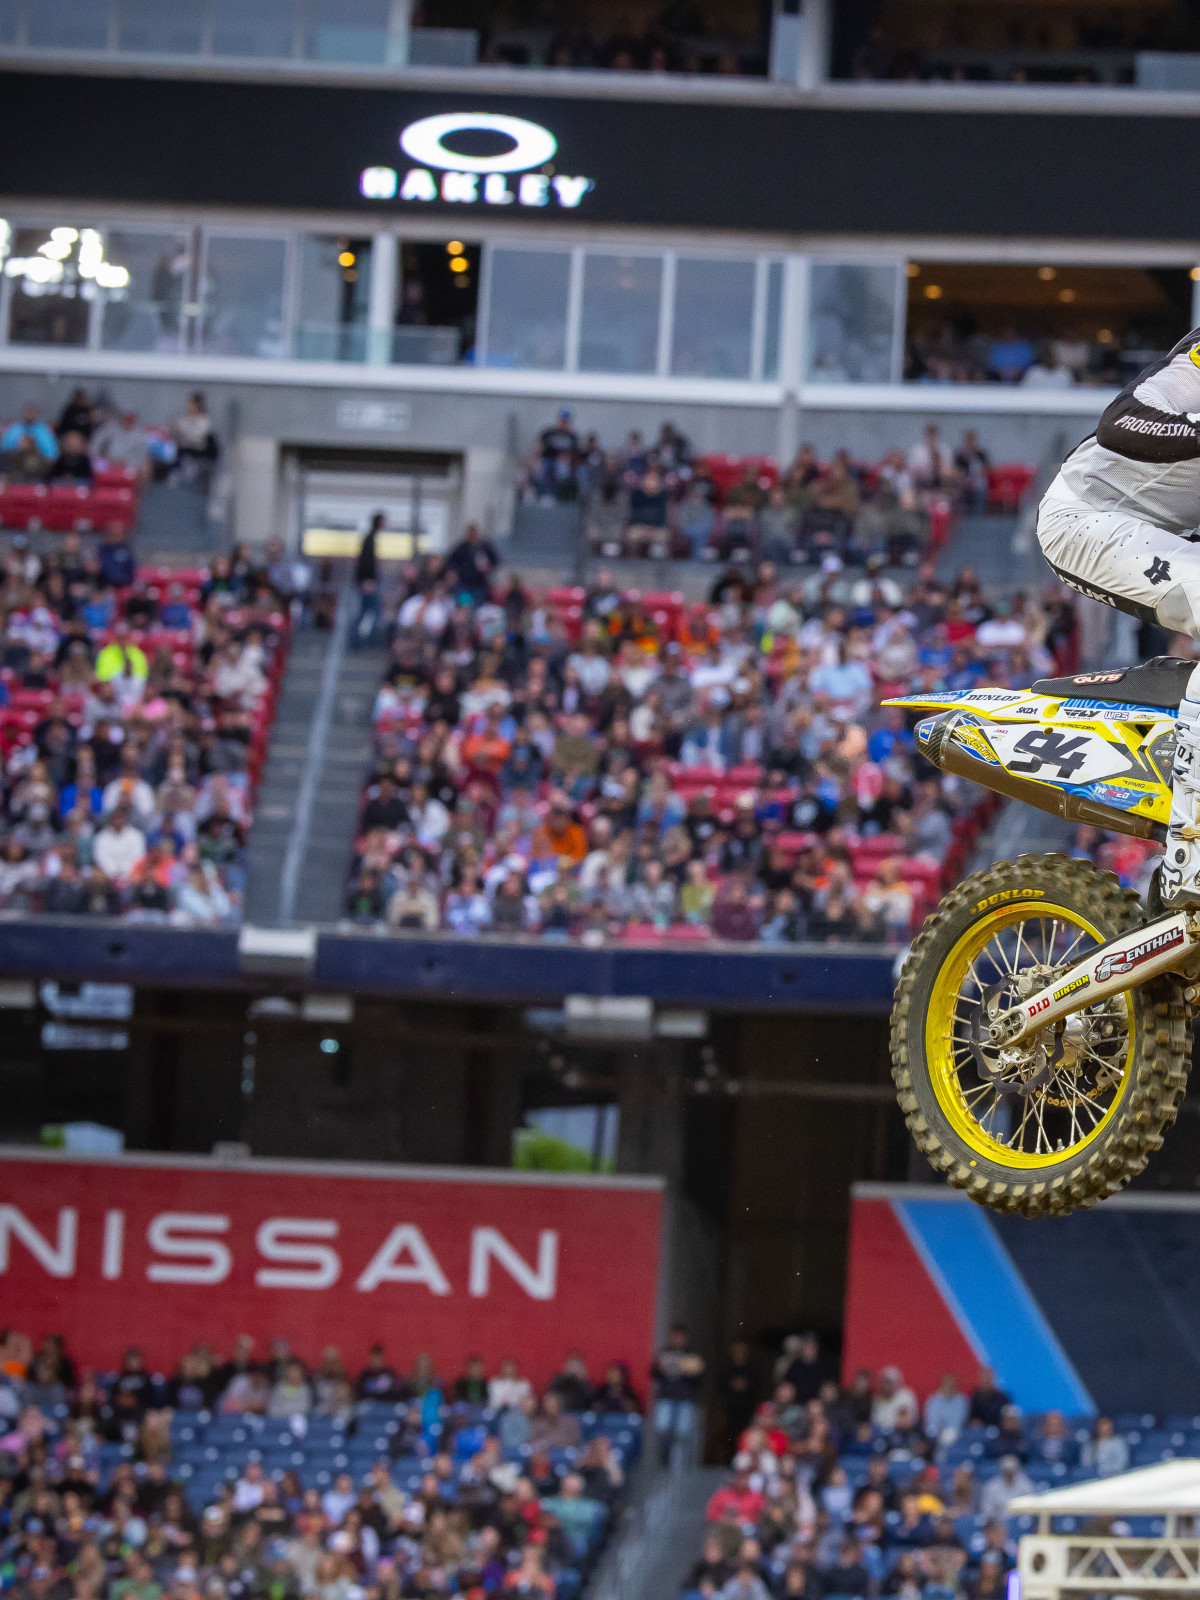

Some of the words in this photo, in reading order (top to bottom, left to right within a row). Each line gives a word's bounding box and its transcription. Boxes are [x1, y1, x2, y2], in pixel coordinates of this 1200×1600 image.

[359, 166, 590, 207] OAKLEY
[1073, 673, 1124, 685] GUTS
[965, 694, 1021, 702] DUNLOP
[1064, 708, 1102, 718] FLY
[1104, 711, 1130, 721] WPS
[1005, 730, 1093, 779] 94
[1177, 745, 1194, 765] OX
[976, 888, 1045, 912] DUNLOP
[1053, 975, 1089, 1000] HINSON
[0, 1206, 559, 1300] NISSAN
